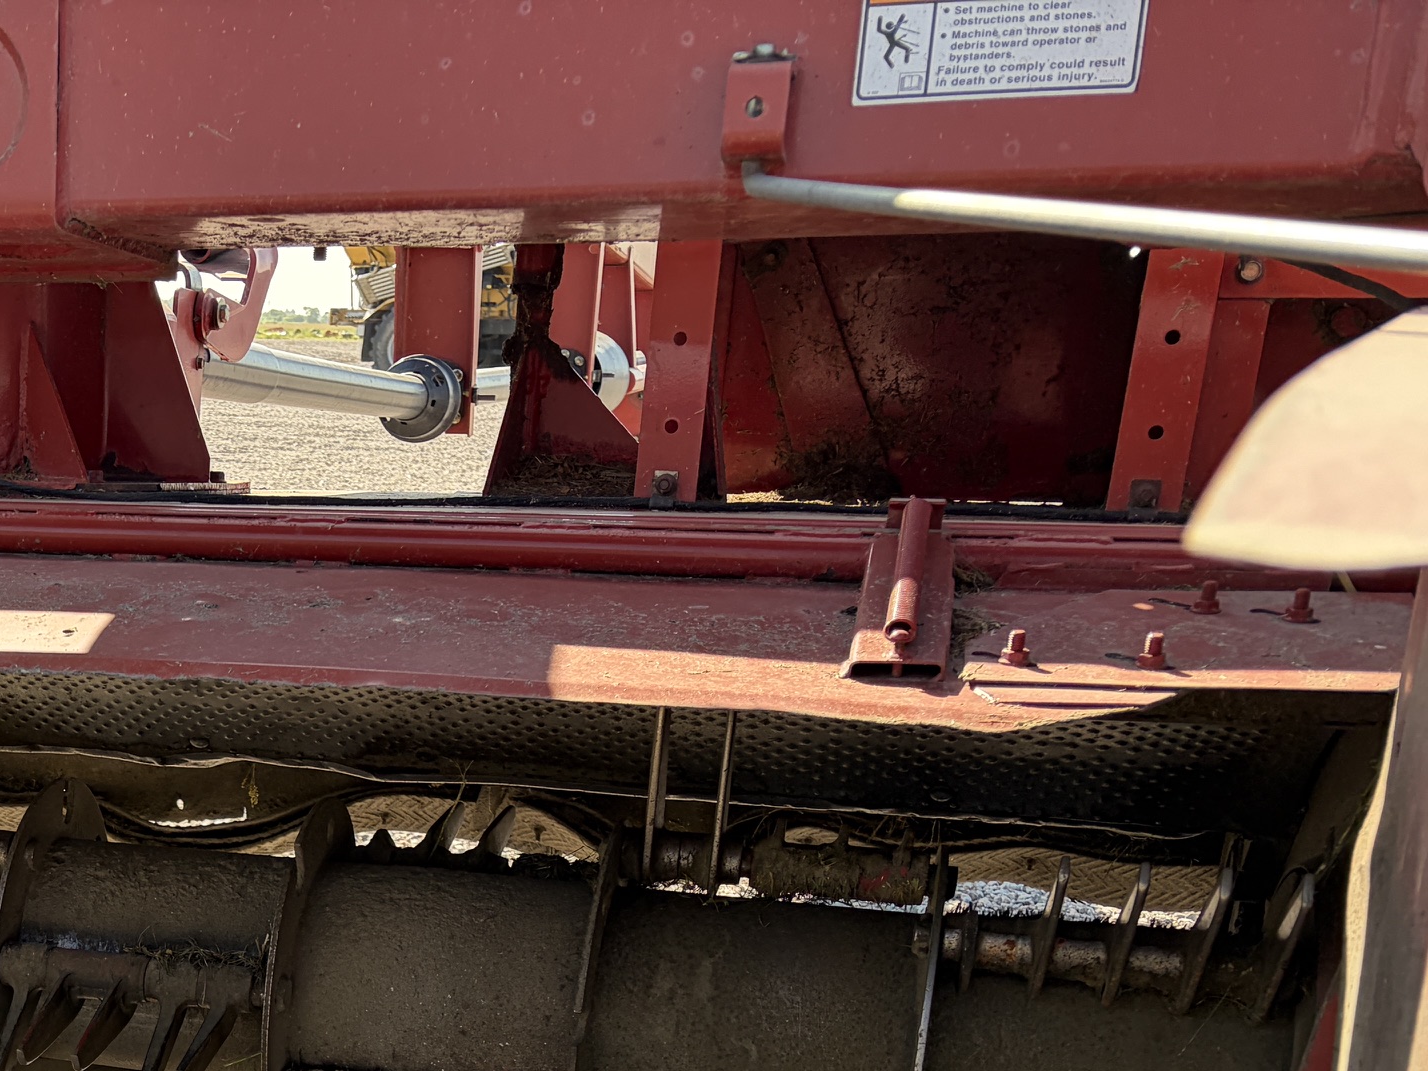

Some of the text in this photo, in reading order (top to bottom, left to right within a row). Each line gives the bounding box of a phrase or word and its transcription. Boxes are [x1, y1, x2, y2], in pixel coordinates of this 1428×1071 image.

[955, 0, 1072, 15] Set machine to clear
[953, 11, 1096, 26] obstructions and stones.
[952, 21, 1127, 39] Machine can throw stones and
[950, 41, 986, 50] debris
[990, 38, 1029, 48] toward
[1032, 36, 1082, 47] operator
[949, 51, 1015, 62] bystanders.
[937, 57, 1126, 75] Failure to comply could result
[936, 71, 1098, 87] in death or serious injury.
